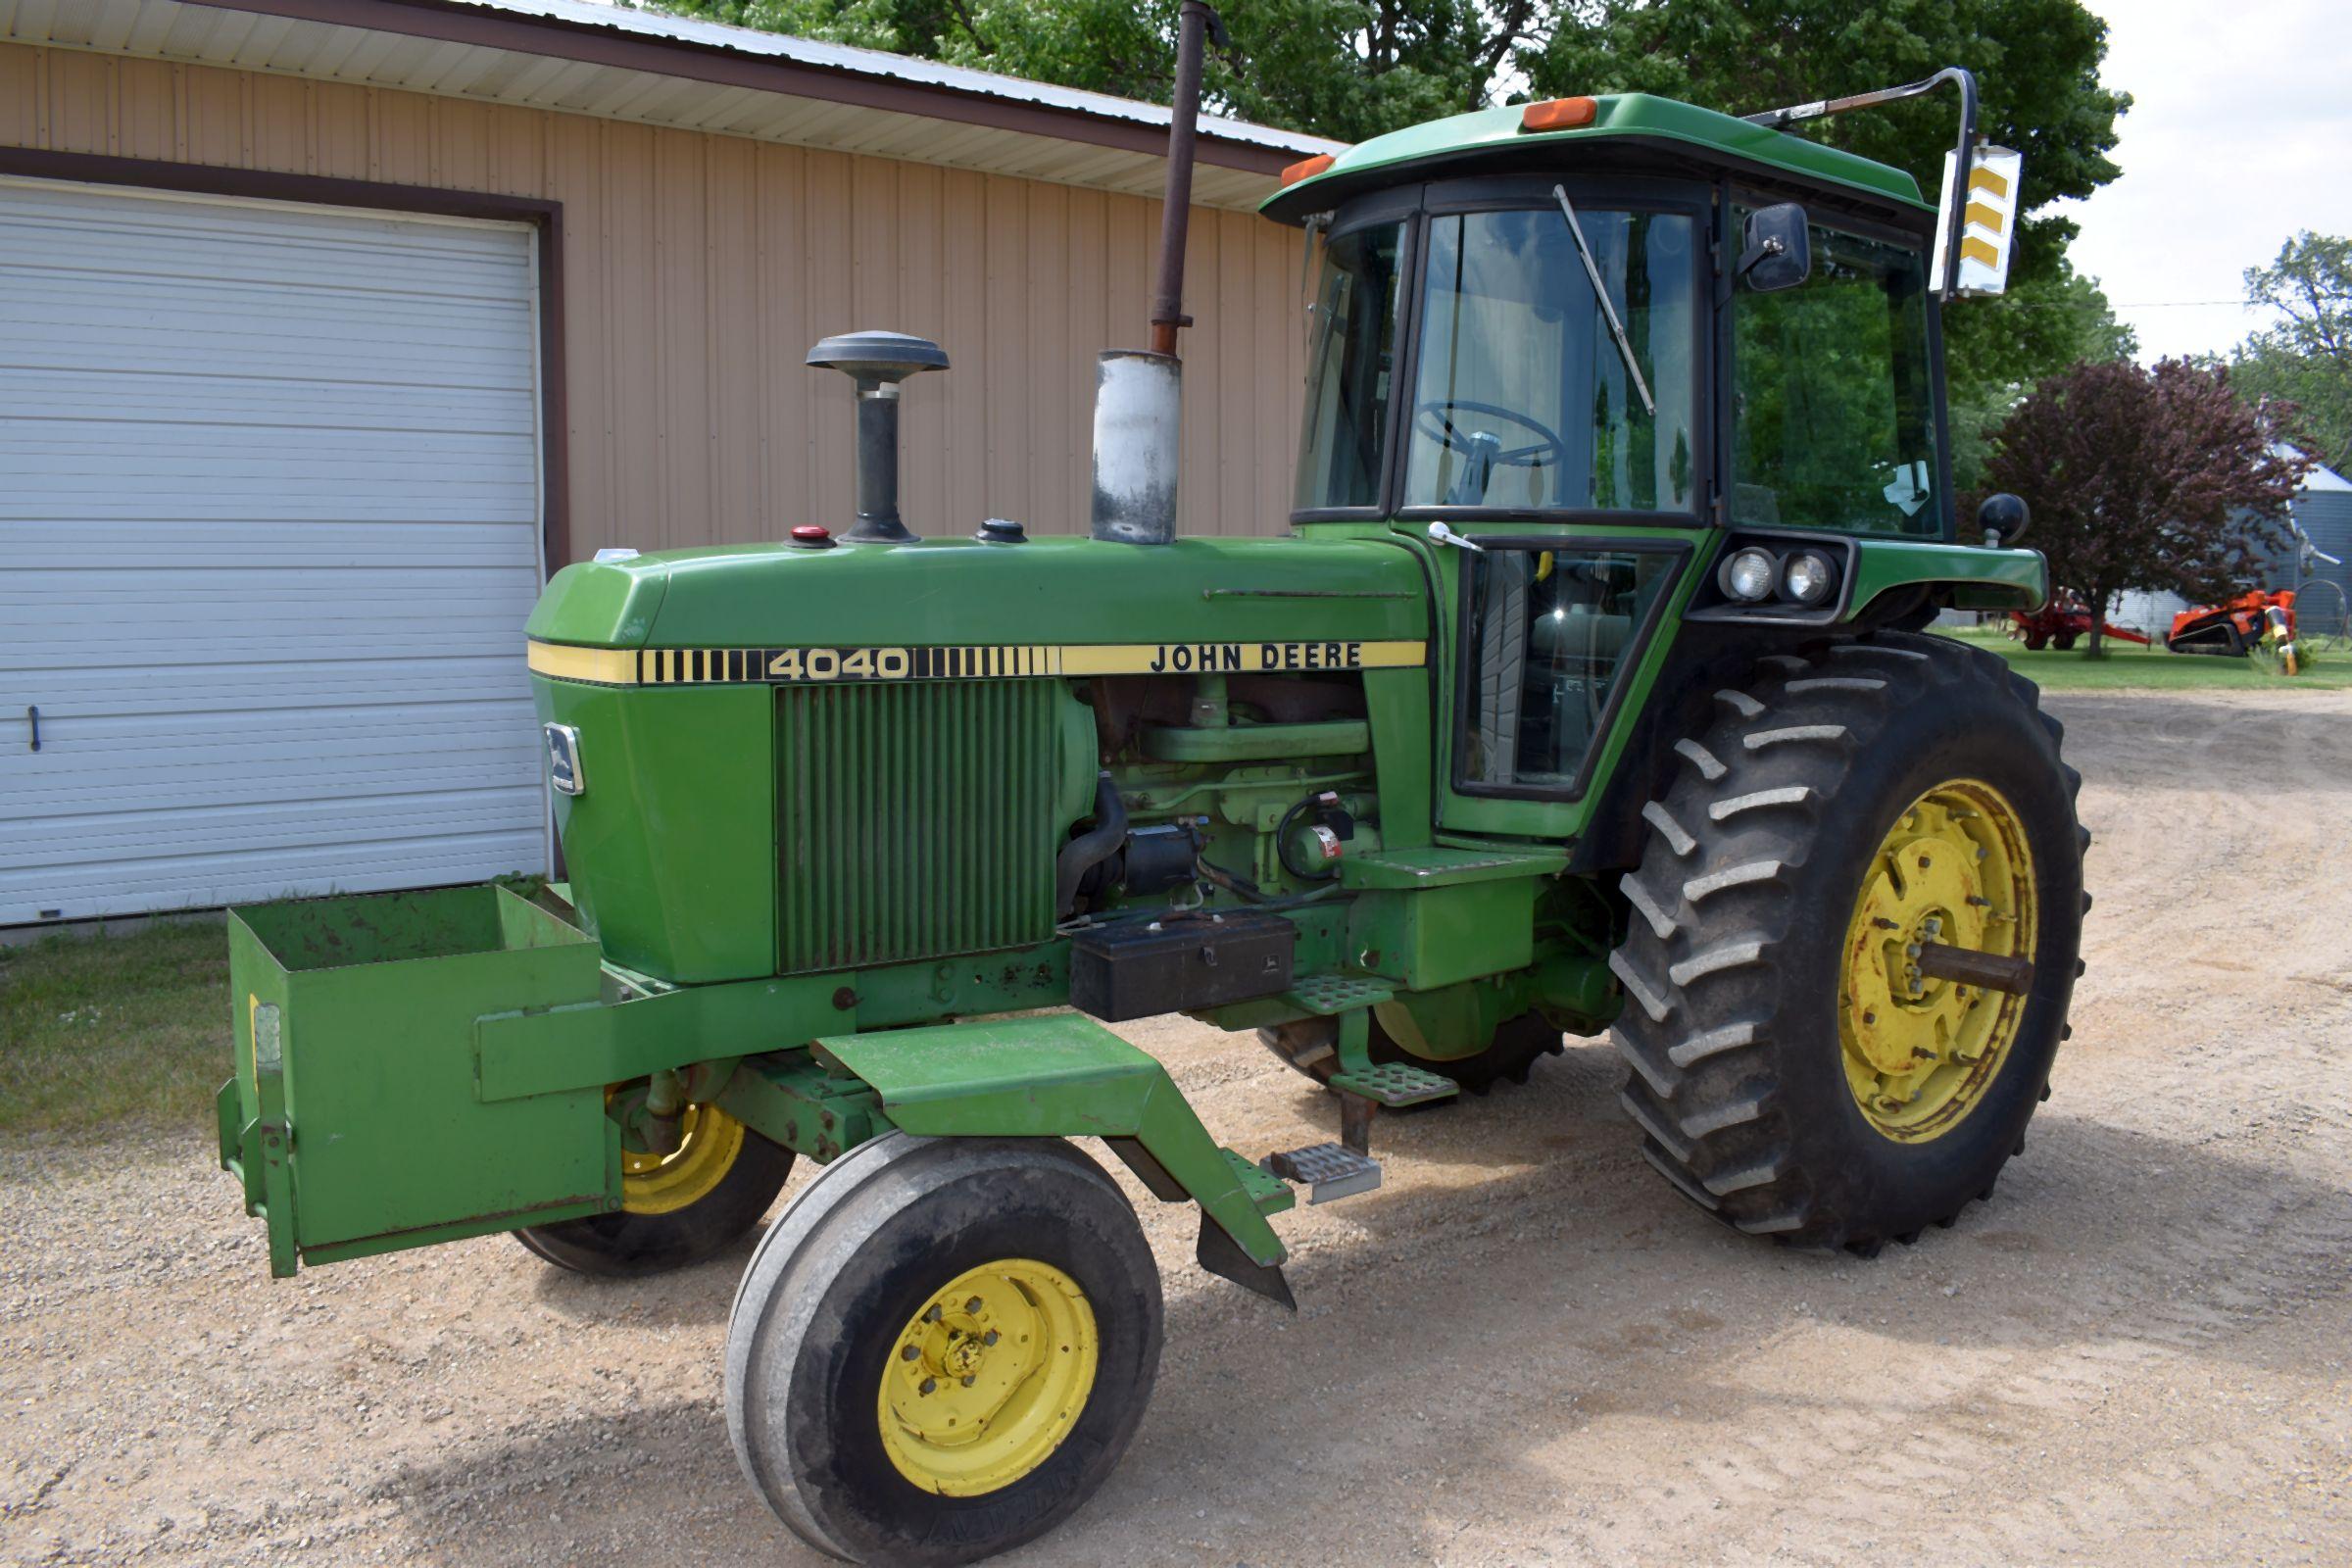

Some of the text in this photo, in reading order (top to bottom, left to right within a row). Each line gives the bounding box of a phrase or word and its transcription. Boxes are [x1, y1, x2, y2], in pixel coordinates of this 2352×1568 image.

[768, 647, 909, 681] 4040
[1151, 642, 1361, 672] JOHN DEERE
